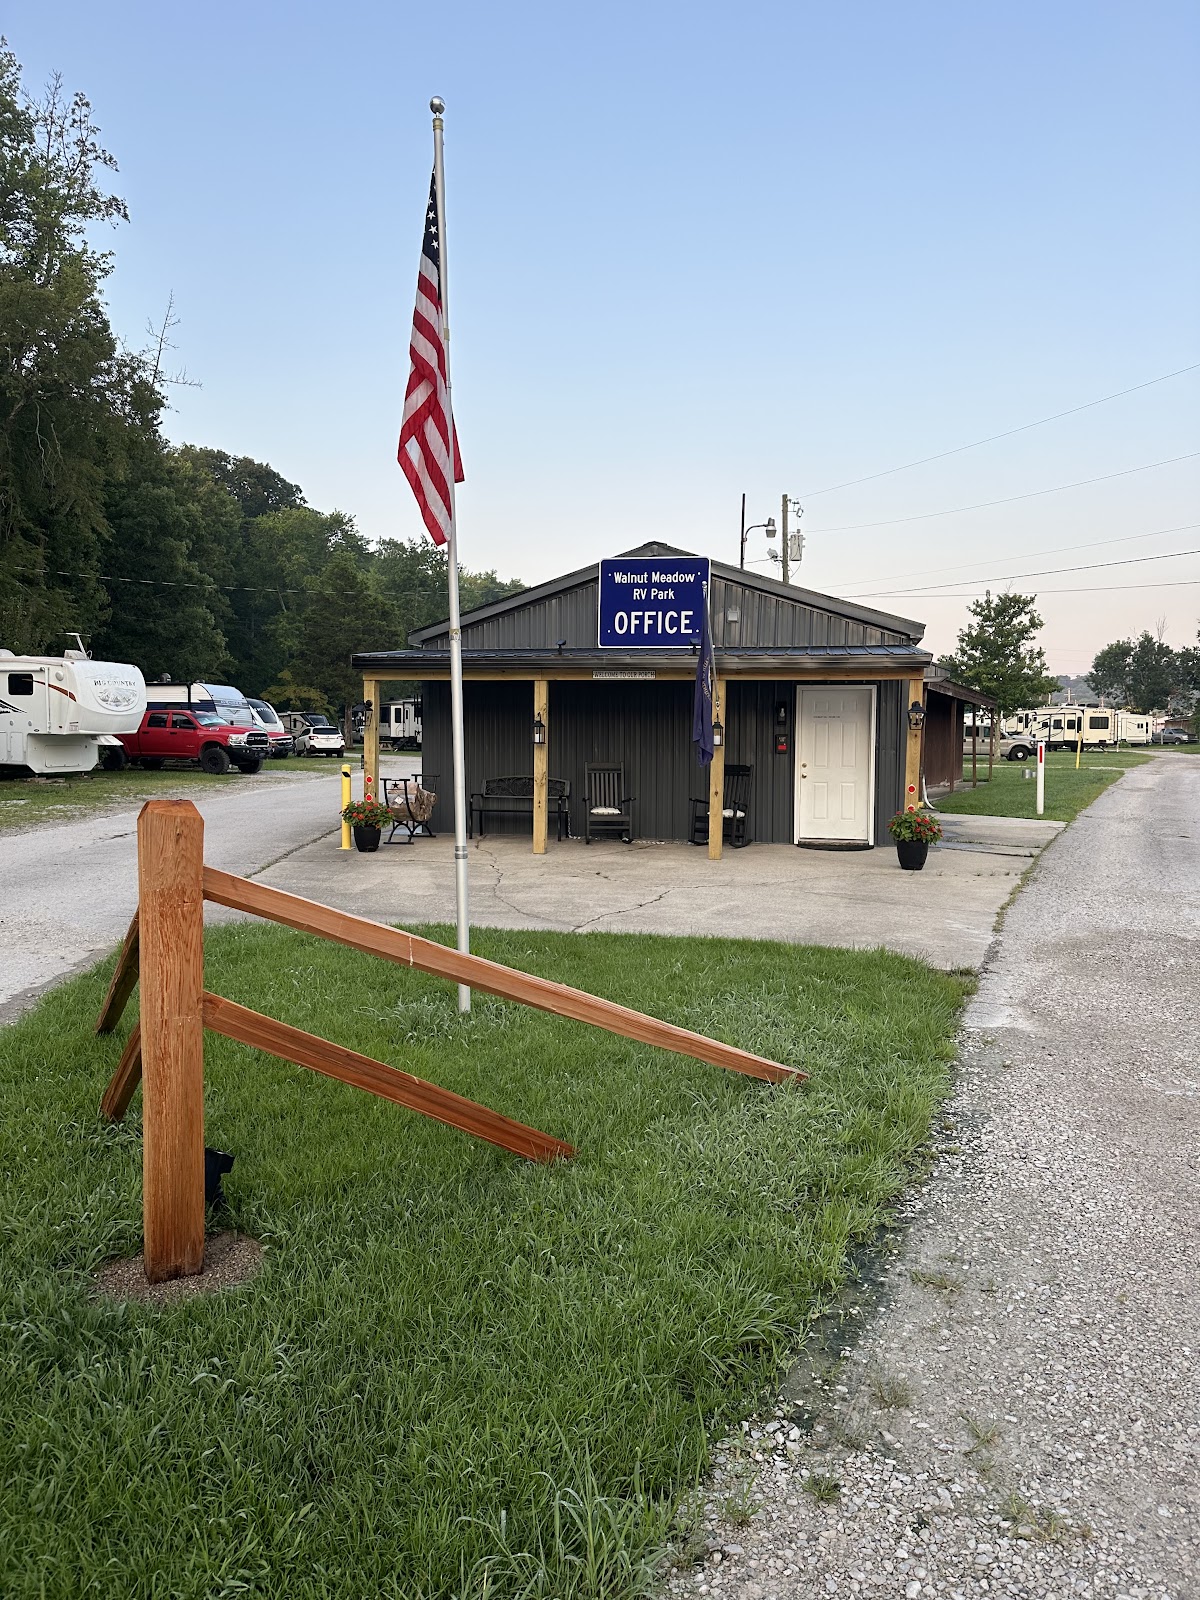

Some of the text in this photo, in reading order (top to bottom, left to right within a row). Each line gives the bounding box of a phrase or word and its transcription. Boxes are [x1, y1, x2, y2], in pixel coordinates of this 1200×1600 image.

[613, 571, 695, 584] Walnut Meadow
[633, 588, 675, 600] RV Park
[614, 610, 694, 635] OFFICE
